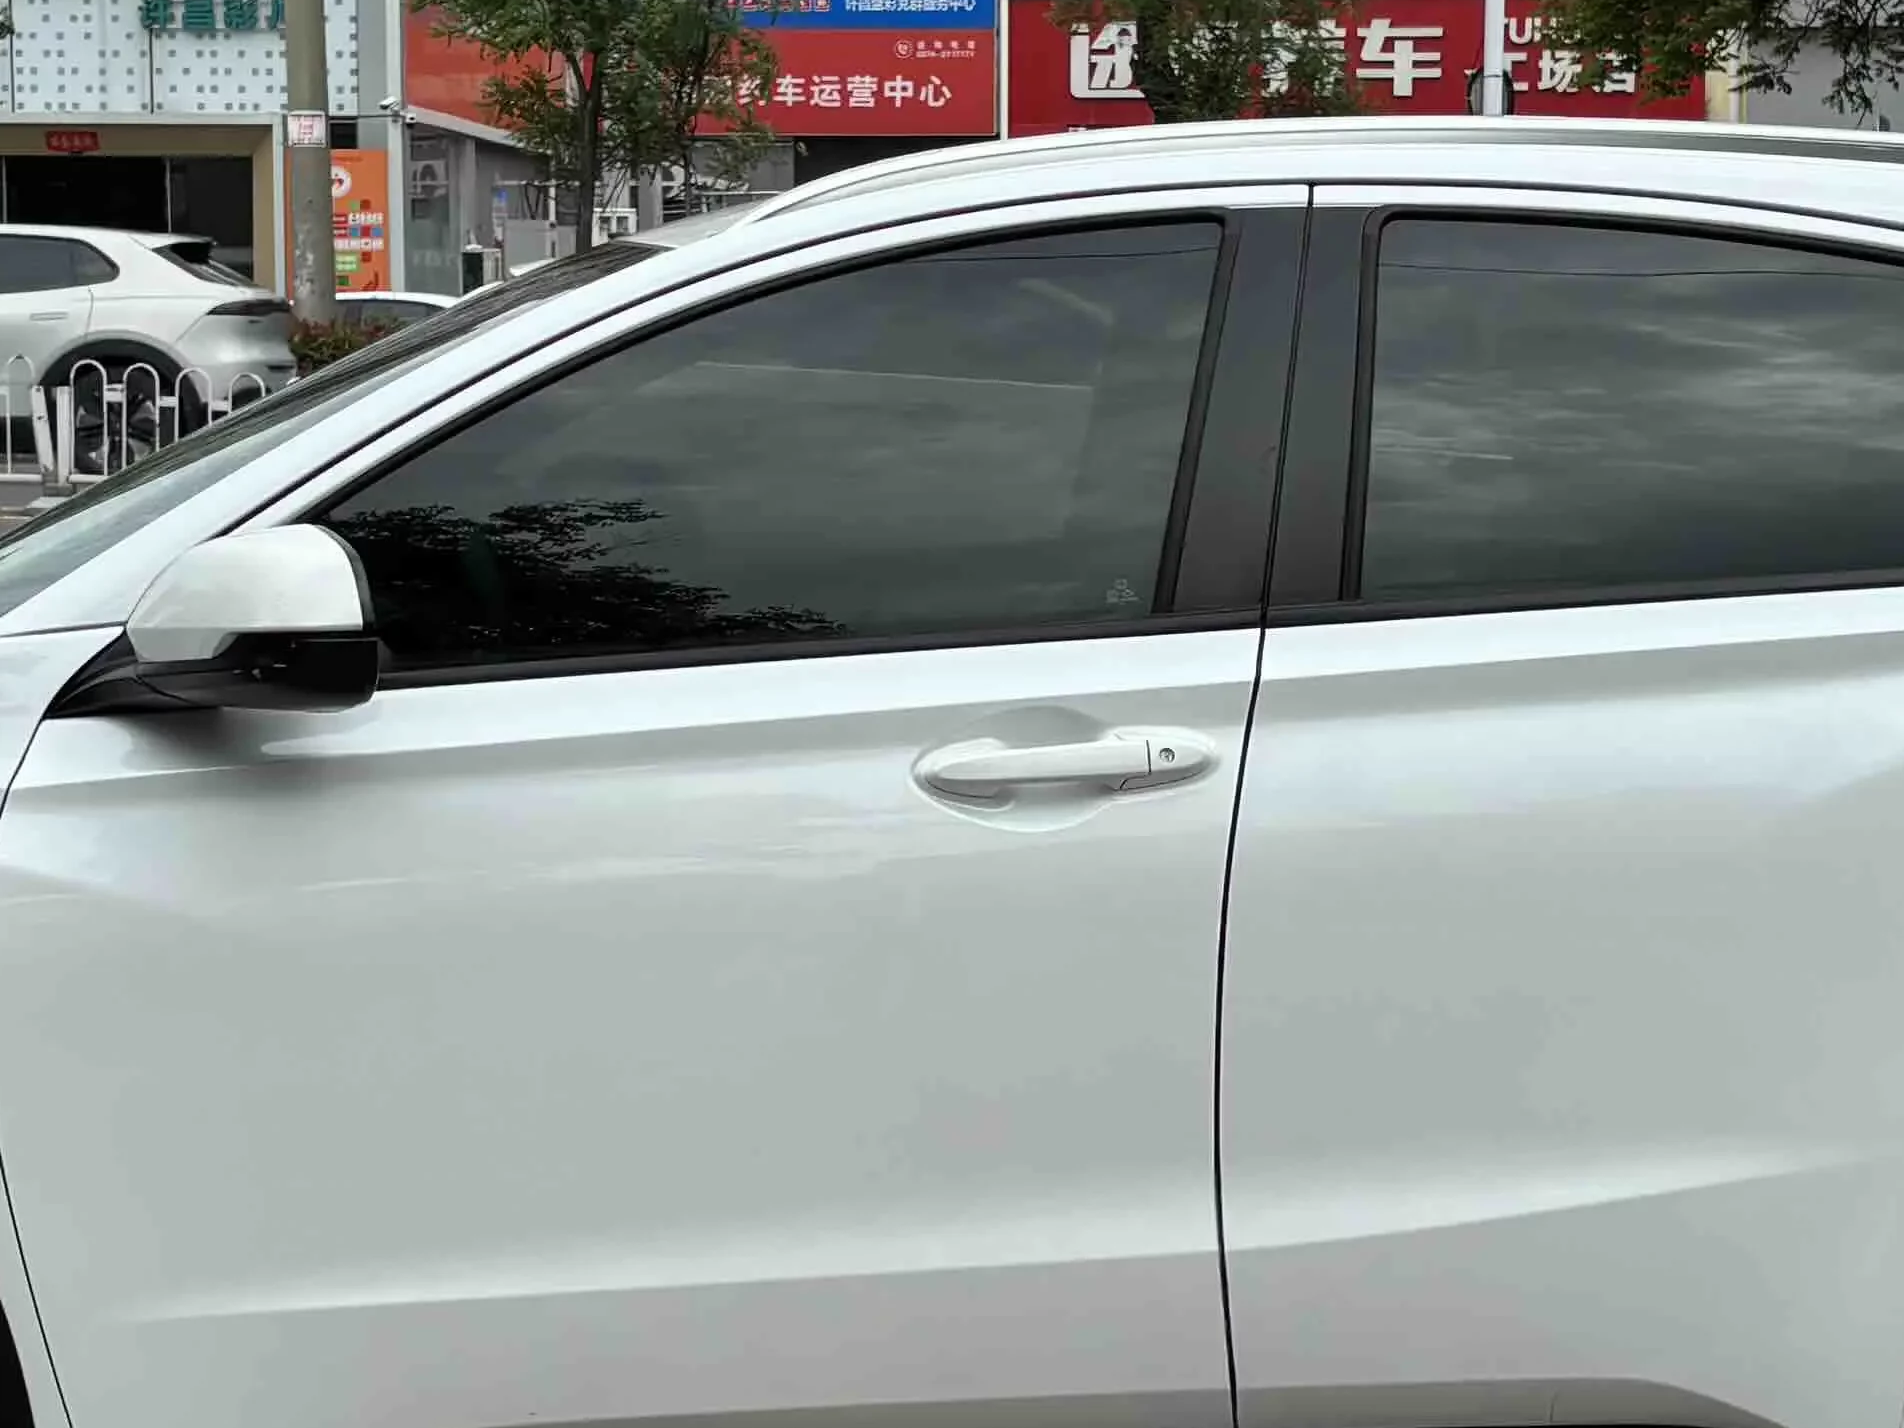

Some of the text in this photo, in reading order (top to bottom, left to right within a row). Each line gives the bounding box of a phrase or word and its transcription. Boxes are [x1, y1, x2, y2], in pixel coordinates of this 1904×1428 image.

[1069, 18, 1444, 99] 途车
[670, 73, 953, 109] 网约车运营中心
